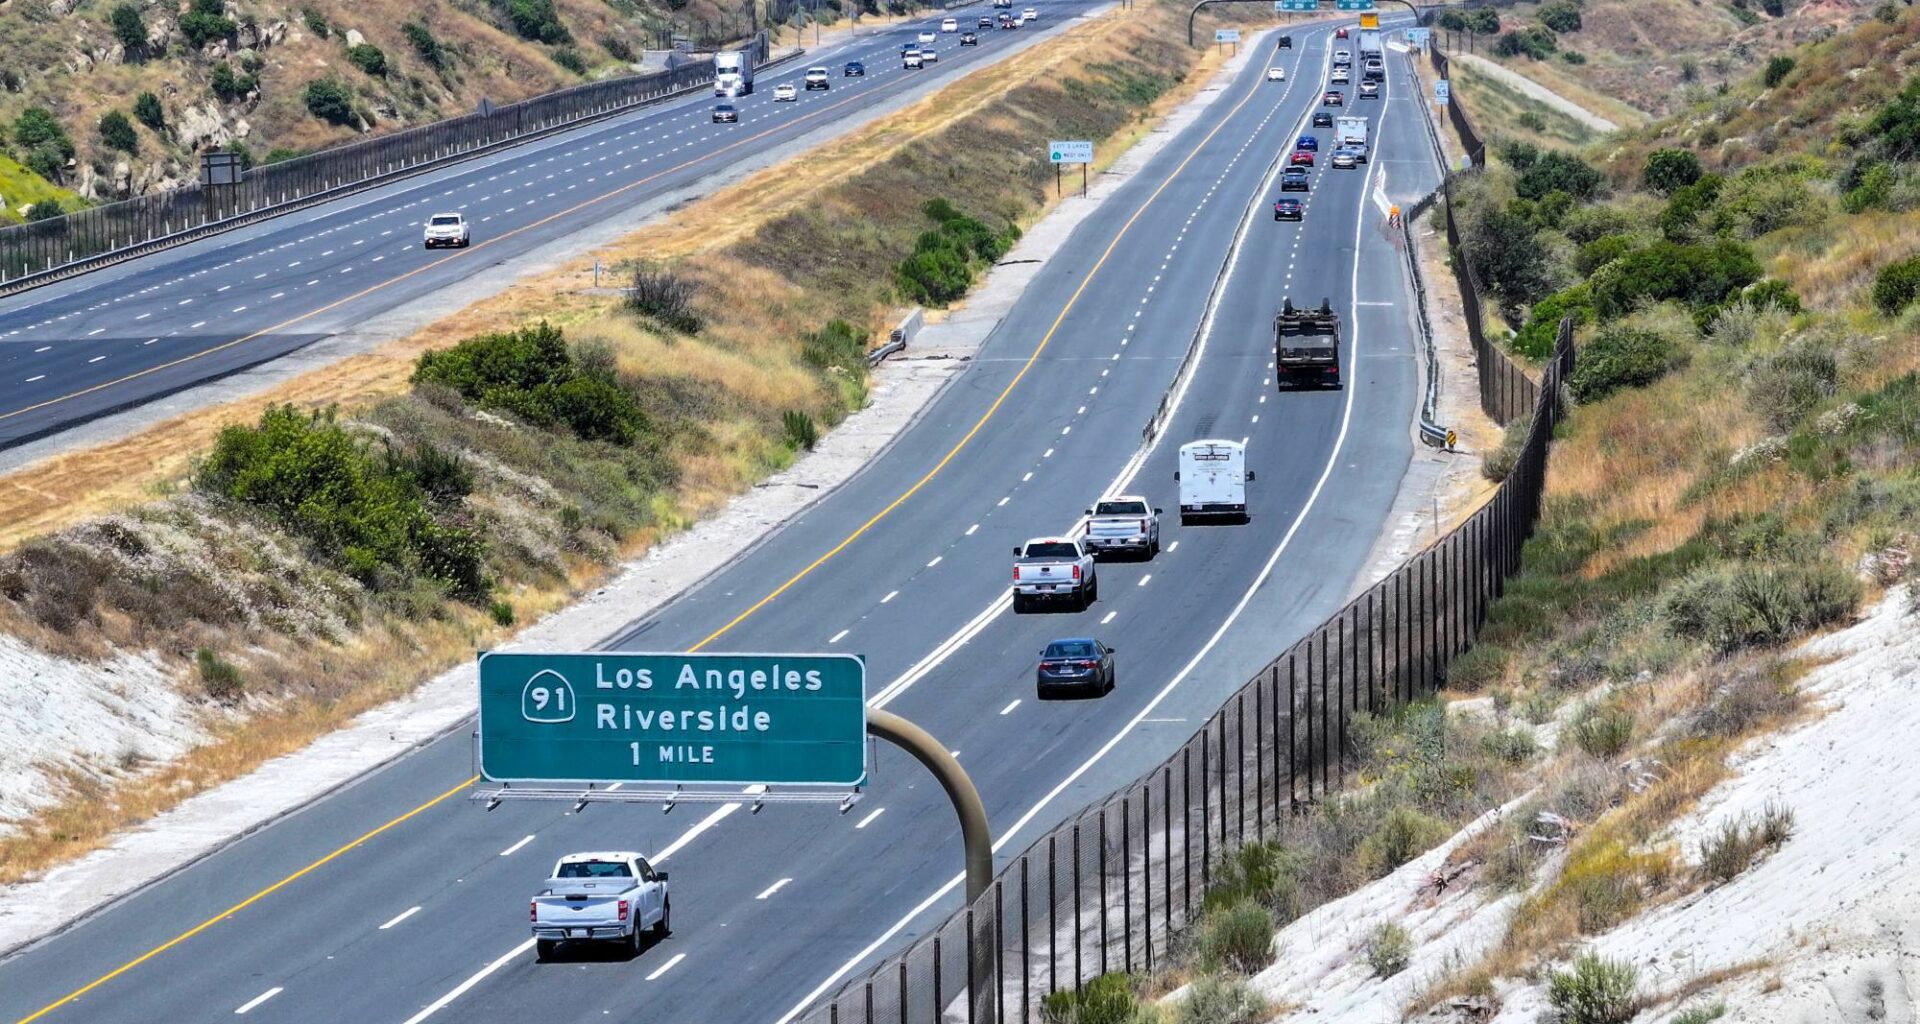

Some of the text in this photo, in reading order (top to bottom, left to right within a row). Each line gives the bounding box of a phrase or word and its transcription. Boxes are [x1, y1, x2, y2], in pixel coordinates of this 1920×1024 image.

[596, 663, 822, 700] Los Angeles
[531, 687, 565, 711] 91
[597, 704, 771, 732] Riverside
[630, 742, 715, 766] 1 MILE
